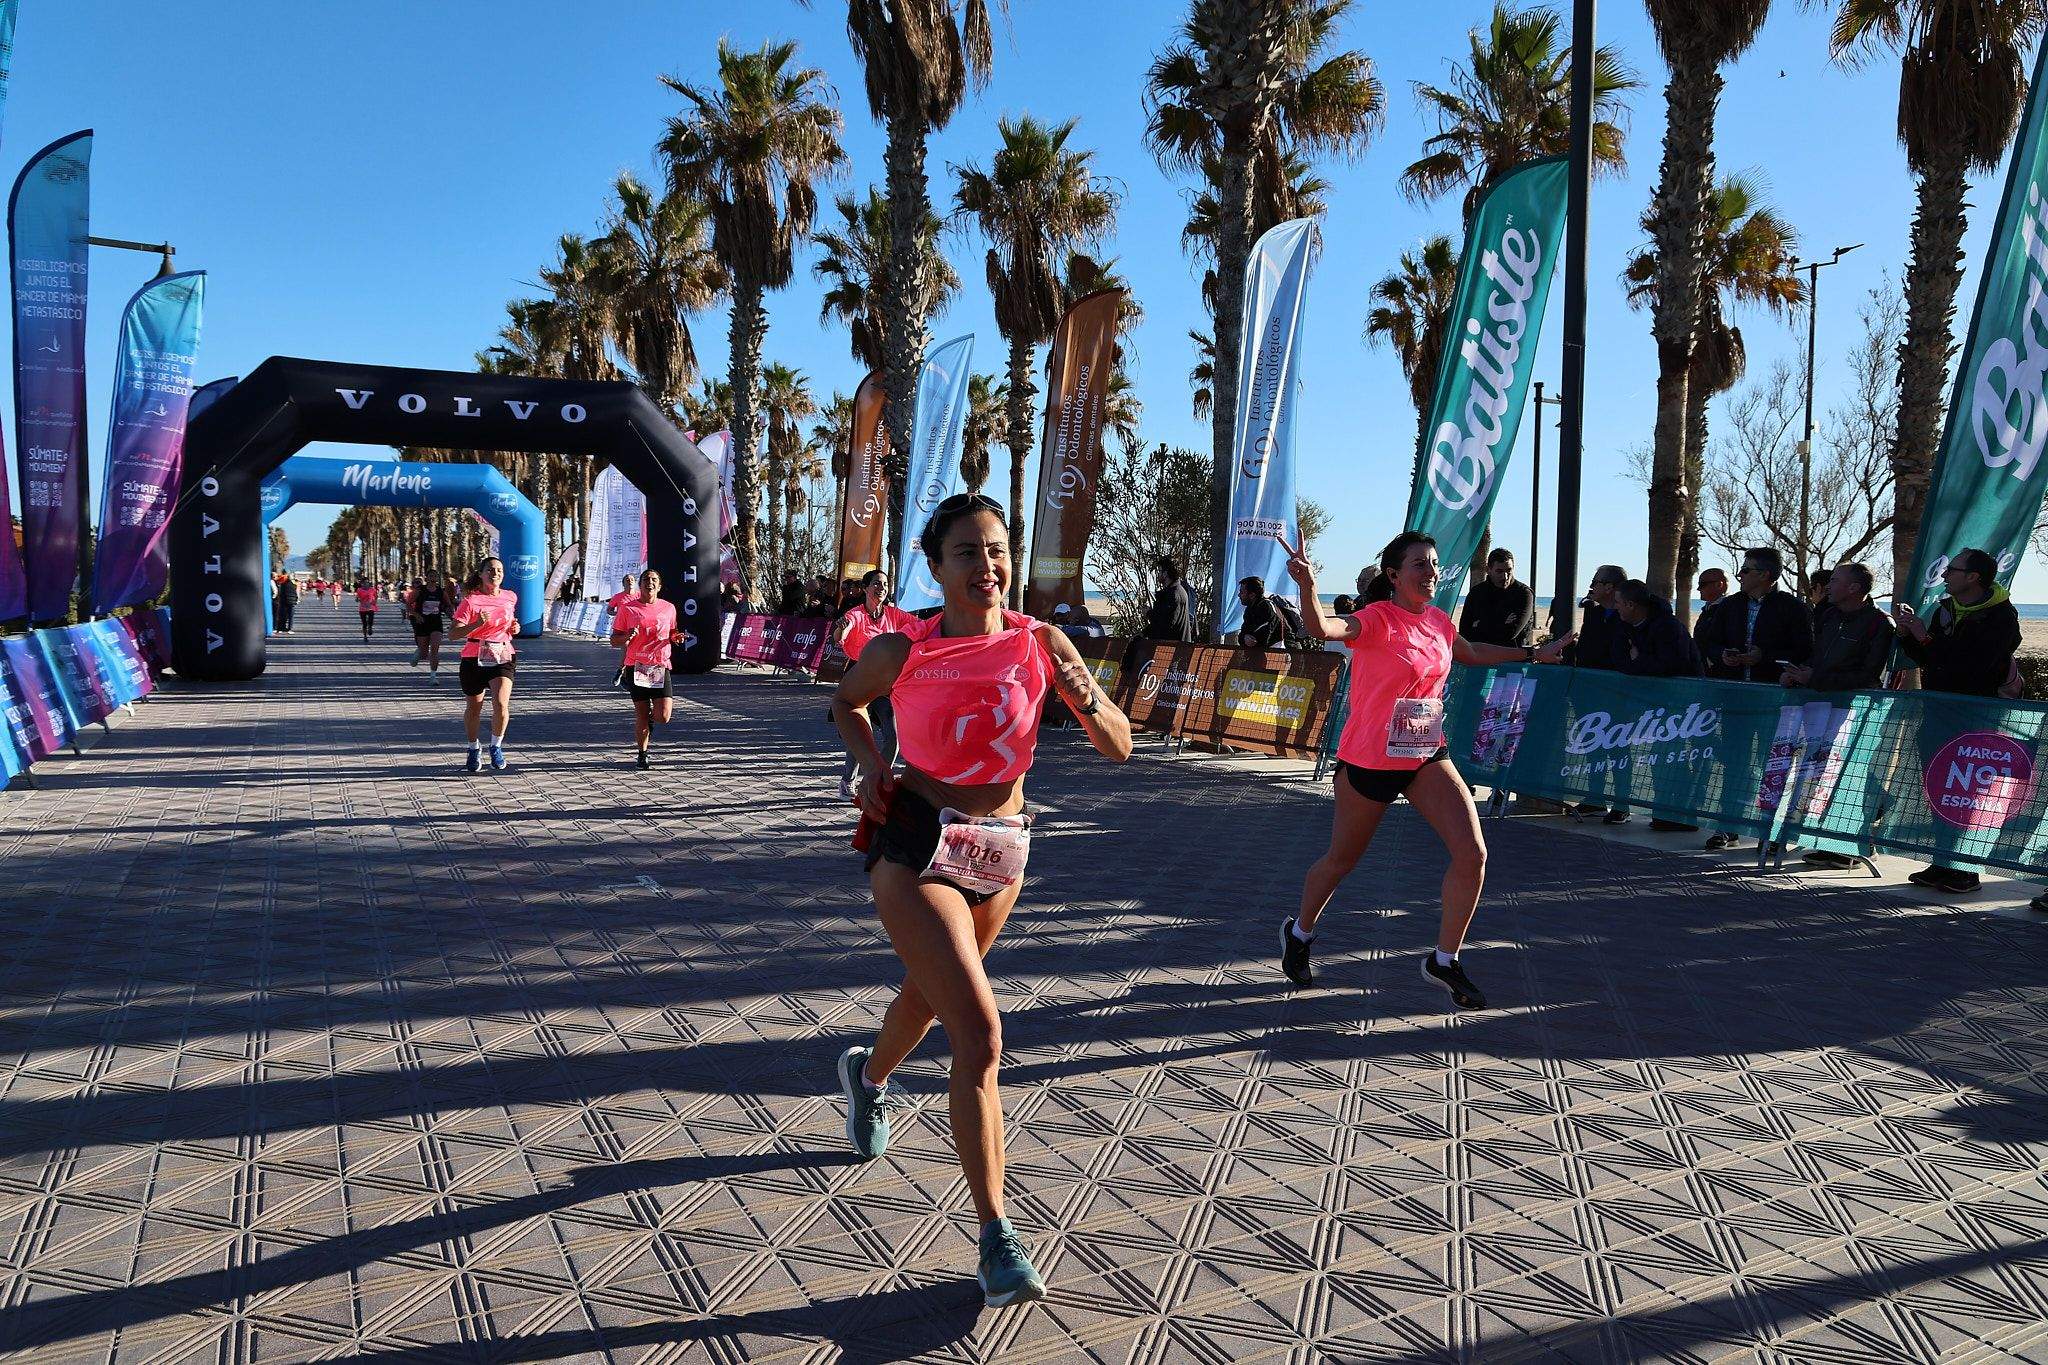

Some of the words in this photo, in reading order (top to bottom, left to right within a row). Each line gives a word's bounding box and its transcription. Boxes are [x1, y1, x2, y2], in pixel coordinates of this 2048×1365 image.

[24, 275, 58, 287] JUNTOS
[60, 277, 72, 288] EL
[48, 292, 59, 302] DE
[158, 373, 170, 382] DE
[171, 375, 193, 386] MAMA
[171, 364, 182, 373] EL
[1264, 316, 1284, 421] Odontológicos
[1427, 228, 1542, 519] Batiste
[1250, 350, 1264, 421] Institutos
[335, 388, 586, 423] VOLVO
[1068, 365, 1090, 459] Odontológicos
[1090, 394, 1099, 427] dentales
[934, 404, 950, 475] Odontológicos
[1055, 394, 1072, 458] Institutos
[28, 445, 62, 461] SÚMATE
[925, 427, 937, 474] Institutos
[1086, 428, 1095, 461] Clínicas
[29, 463, 66, 473] MOVIMIENT
[860, 442, 872, 490] Institutos
[123, 481, 160, 495] SÚMATE
[342, 464, 431, 499] Marlene
[1237, 520, 1254, 528] 900
[1268, 522, 1282, 530] 002
[201, 476, 224, 654] VOLVO
[683, 498, 698, 652] VOLVO
[760, 624, 782, 645] renfe
[793, 628, 817, 650] renfe
[914, 670, 960, 679] OYSHO
[1165, 669, 1199, 683] Institutos
[1228, 677, 1255, 694] 900
[1279, 684, 1307, 702] 002
[1160, 682, 1215, 700] Odontológicos
[1565, 703, 1719, 755] Batiste
[1560, 755, 1628, 777] CHAMPÚ
[1636, 753, 1658, 768] EN
[1666, 747, 1713, 764] SECO
[1957, 745, 2013, 763] MARCA
